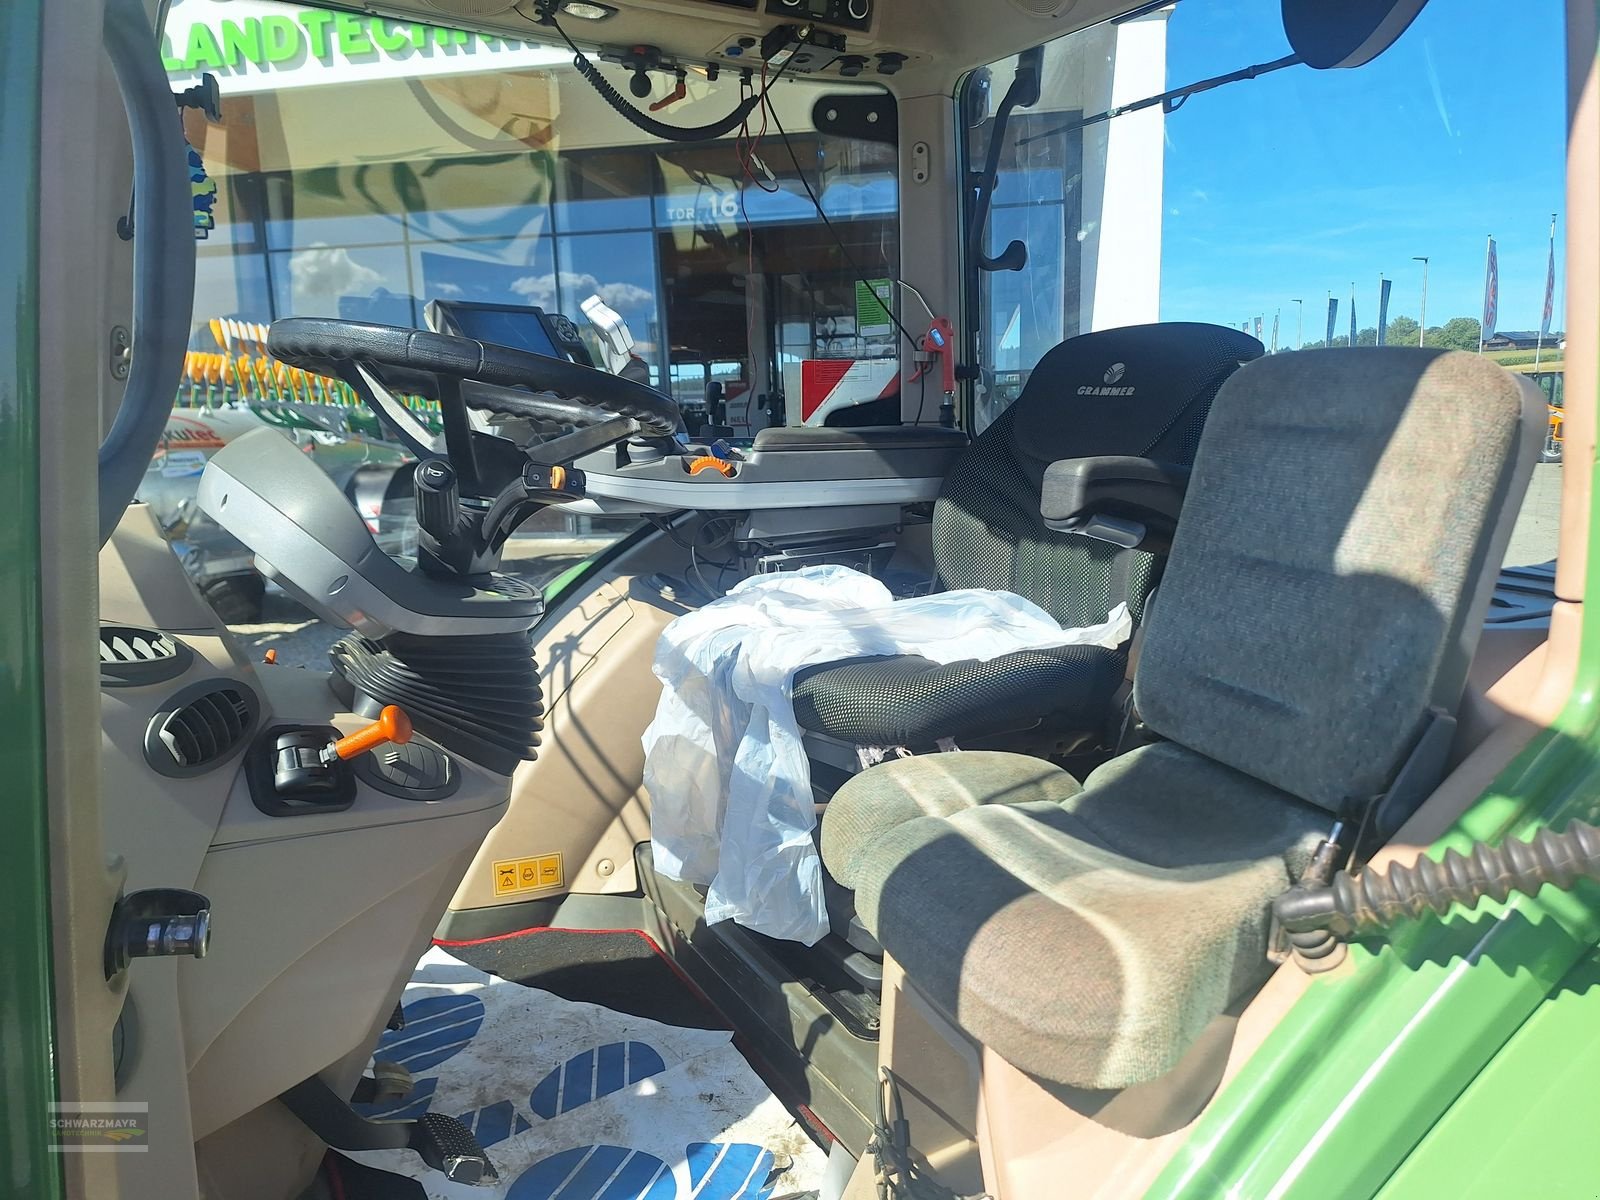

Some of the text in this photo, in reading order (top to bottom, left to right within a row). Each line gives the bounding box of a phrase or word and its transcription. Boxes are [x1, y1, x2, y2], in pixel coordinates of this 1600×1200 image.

[161, 10, 492, 71] ANDTEC
[666, 193, 739, 220] TOR 16
[1076, 385, 1136, 396] GRAMMER
